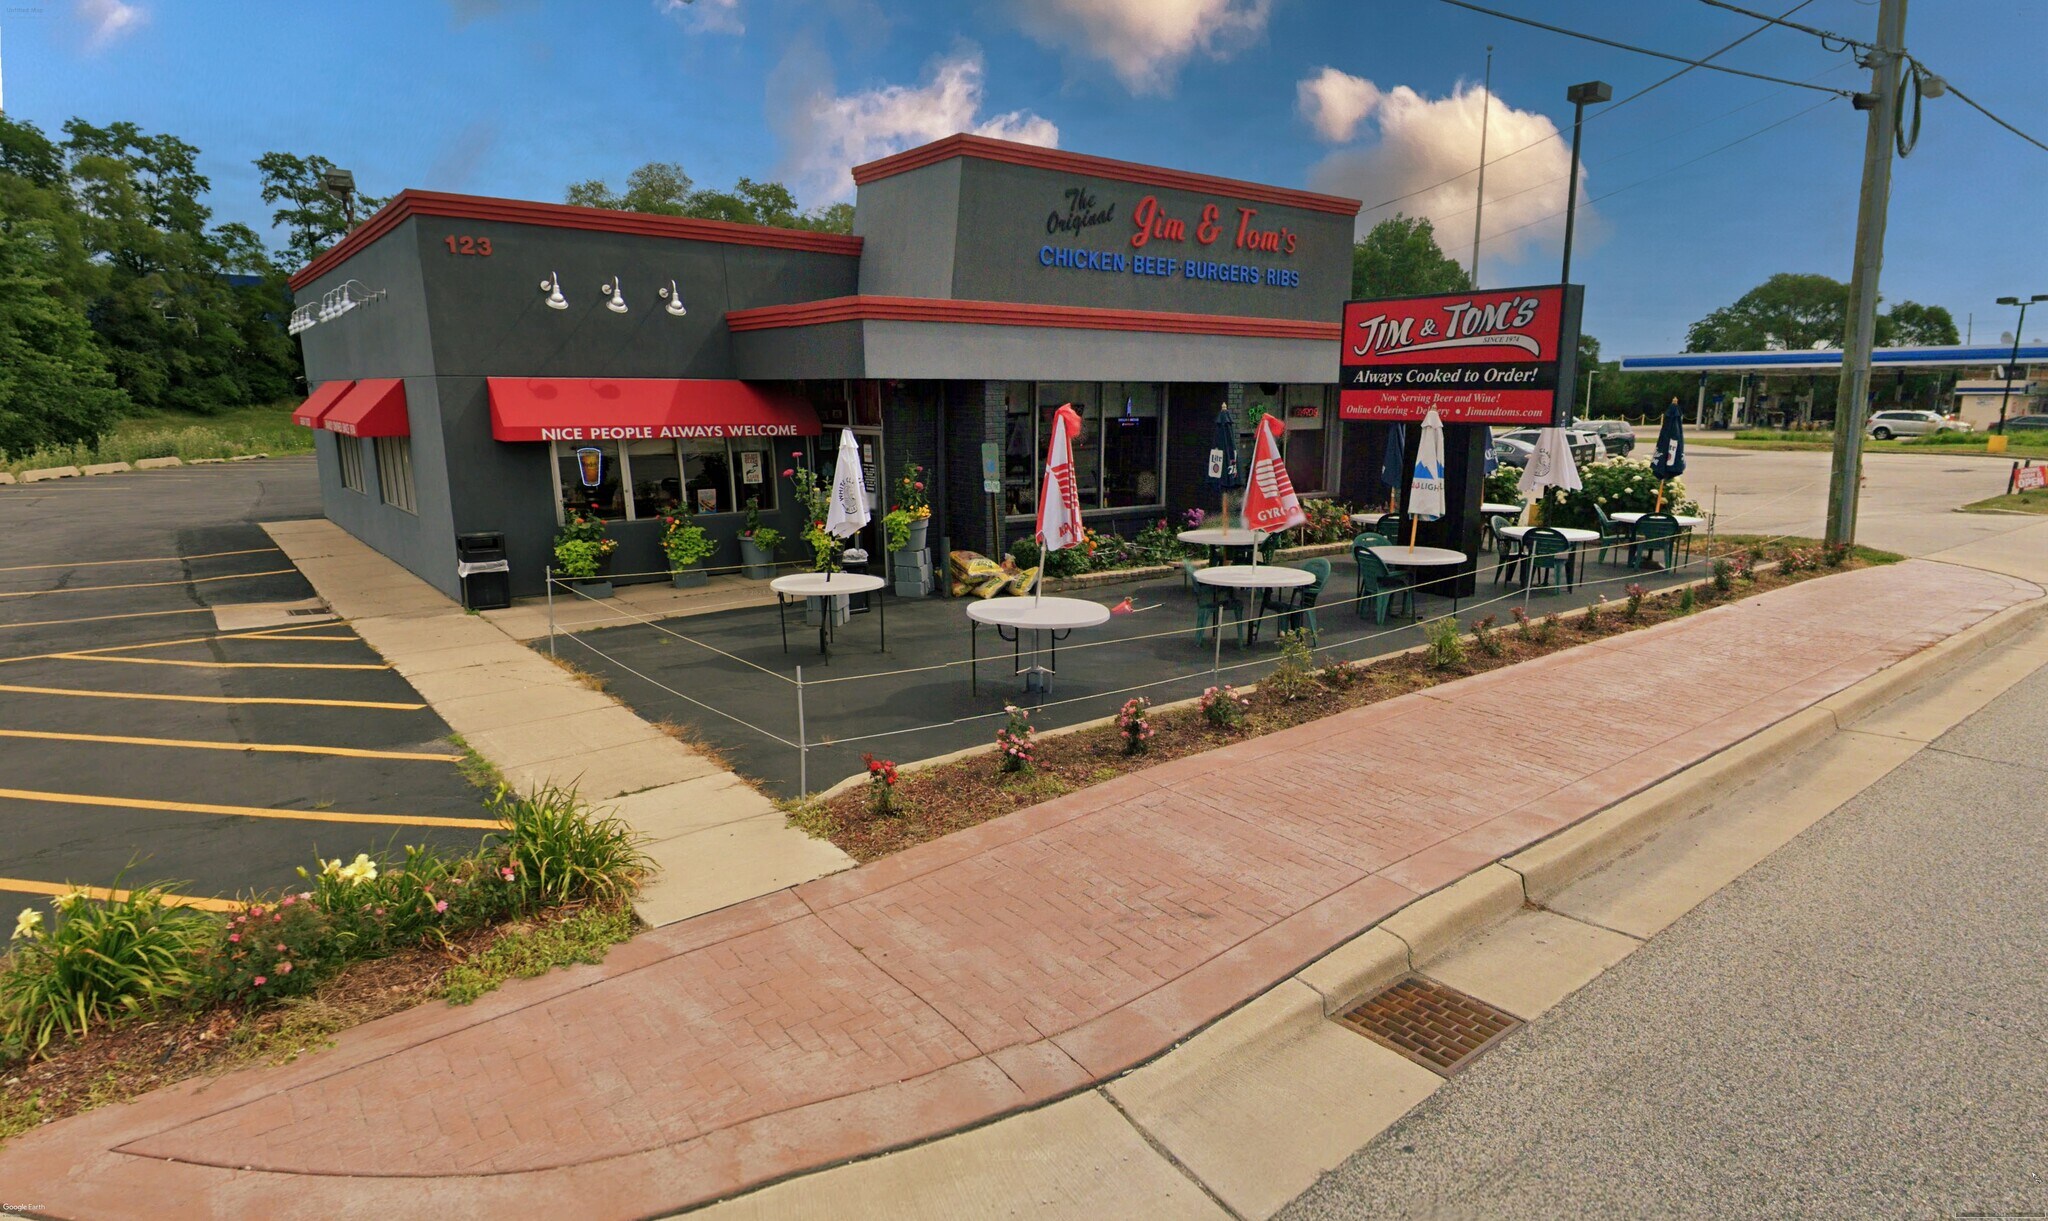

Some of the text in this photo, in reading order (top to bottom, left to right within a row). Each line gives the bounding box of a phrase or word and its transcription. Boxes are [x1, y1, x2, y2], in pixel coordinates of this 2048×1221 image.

[1065, 187, 1096, 212] The
[1046, 202, 1115, 237] Original
[1130, 194, 1297, 255] Jim & Tom's
[443, 234, 493, 257] 123
[1038, 245, 1300, 288] CHICKEN BEEF BURGERS RIBS
[1353, 296, 1540, 356] JIM & TOM'S
[1483, 335, 1520, 344] SINCE 1974
[1353, 367, 1539, 386] Always Cooked to Order!
[1381, 393, 1501, 404] Now Serving Beer and Wine!
[1346, 405, 1371, 414] Online
[1373, 405, 1408, 416] Ordering
[1415, 405, 1450, 417] Delery
[1464, 406, 1543, 417] Jimandtoms.com
[541, 424, 798, 440] NICE PEOPLE ALWAYS WELCOME
[1211, 454, 1223, 463] Lite
[2018, 476, 2045, 488] OPEN
